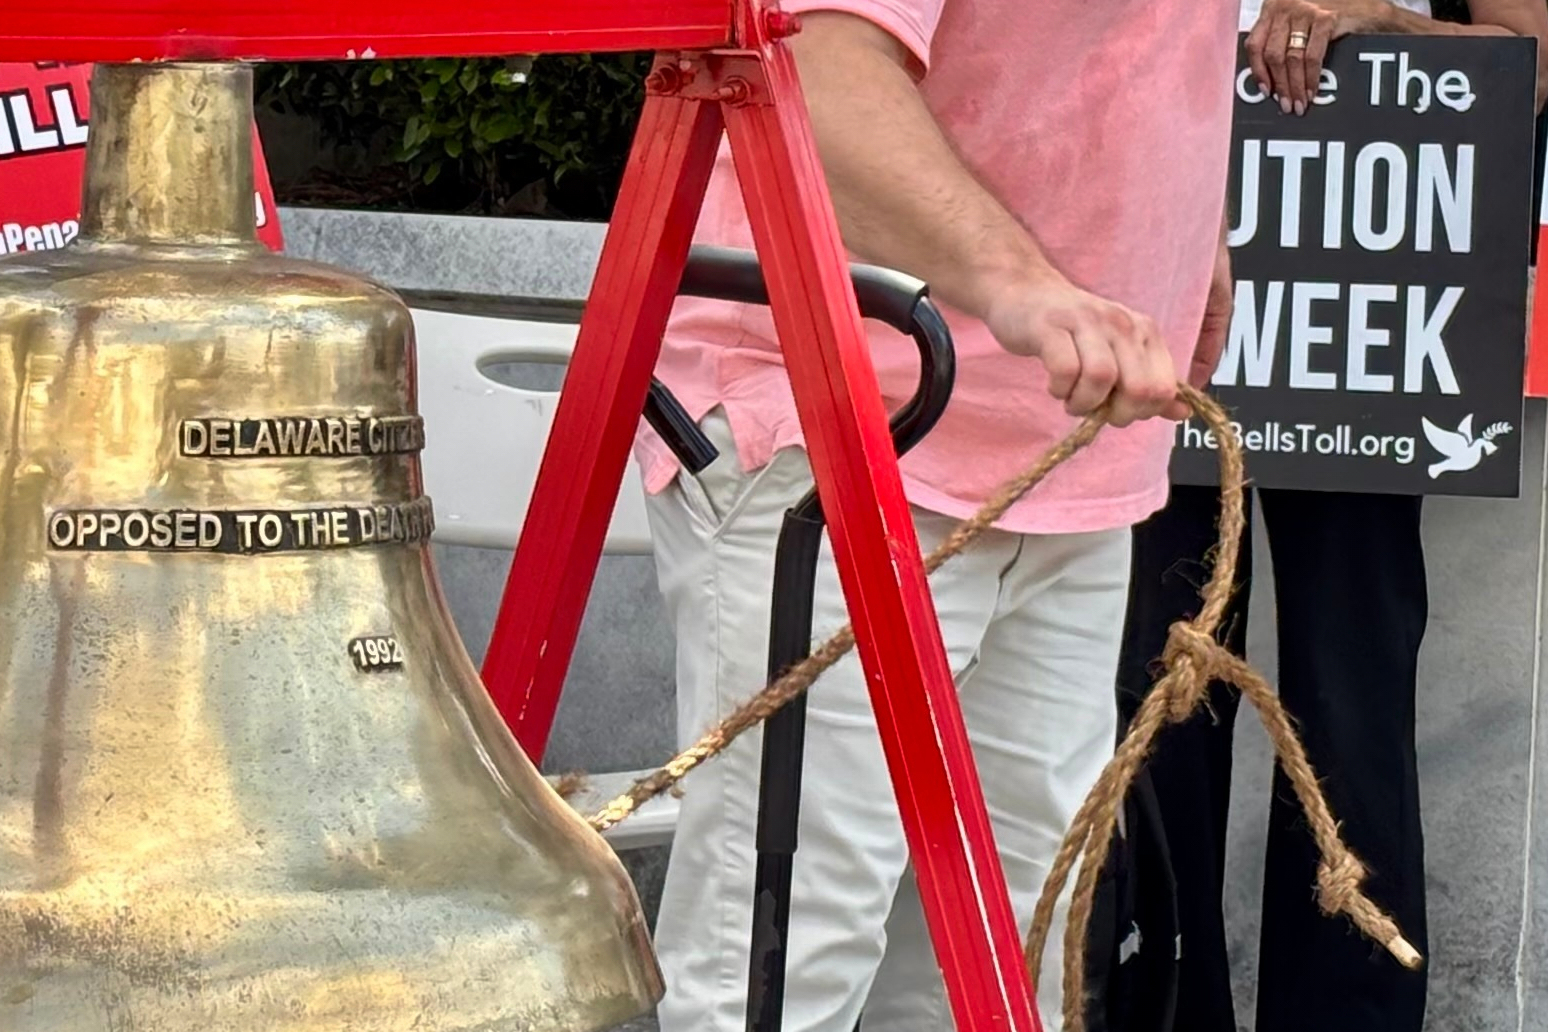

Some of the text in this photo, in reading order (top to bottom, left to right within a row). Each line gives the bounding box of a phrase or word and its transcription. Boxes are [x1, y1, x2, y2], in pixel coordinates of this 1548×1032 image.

[1358, 52, 1477, 113] The
[1211, 280, 1465, 395] WEEK
[184, 417, 361, 456] DELAWARE
[50, 512, 223, 548] OPPOSED
[237, 514, 283, 549] TO
[292, 511, 351, 546] THE
[352, 638, 403, 667] 1992
